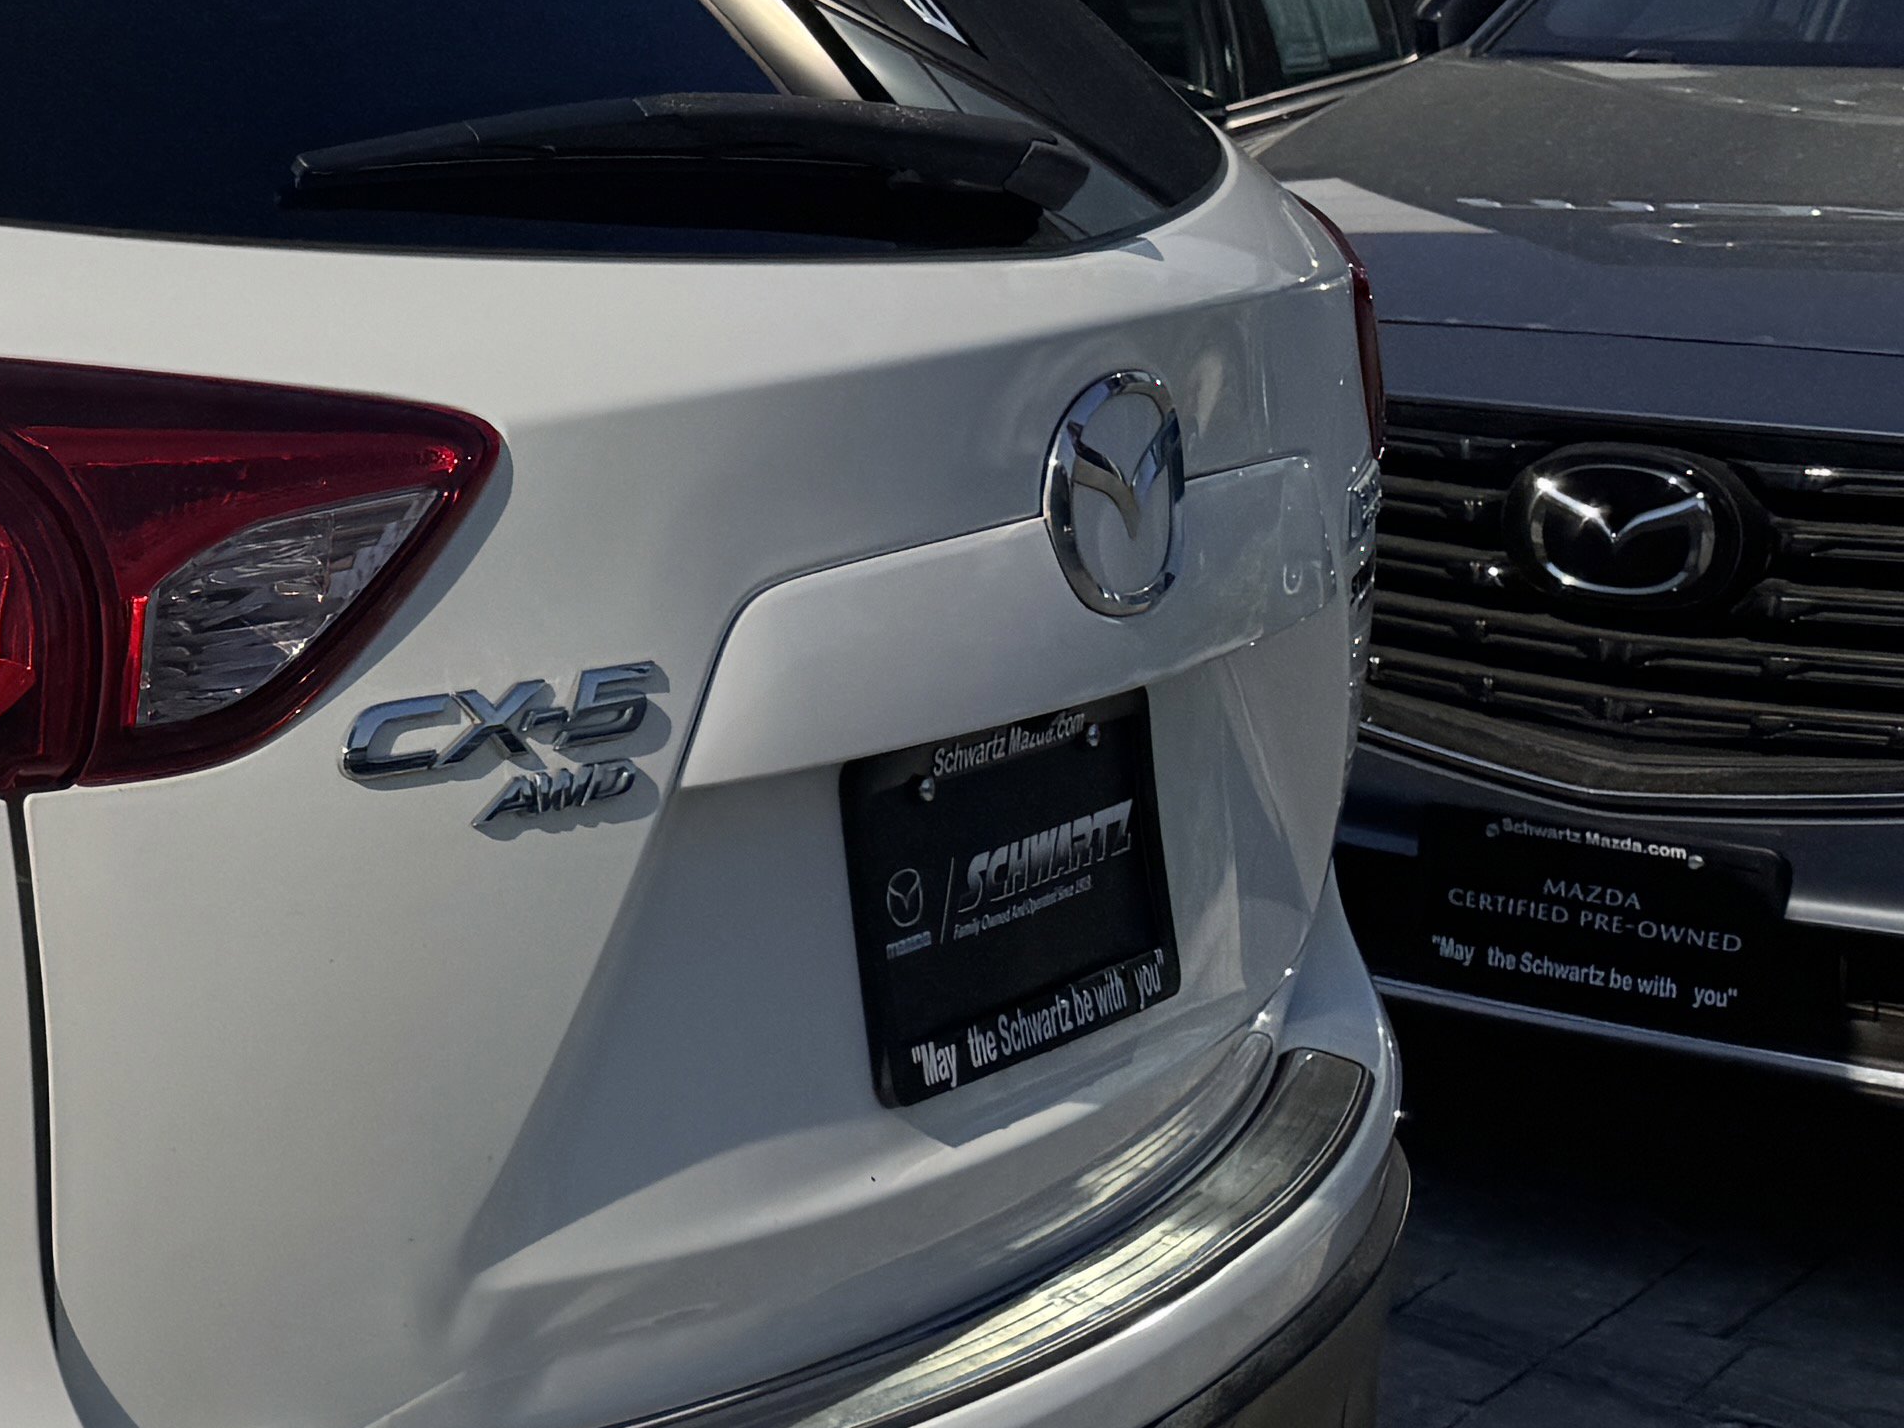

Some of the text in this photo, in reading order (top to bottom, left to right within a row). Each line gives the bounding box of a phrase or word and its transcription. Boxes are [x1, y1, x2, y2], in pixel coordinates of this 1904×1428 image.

[339, 660, 656, 780] CX-5
[933, 733, 1007, 777] Schwartz
[471, 758, 636, 827] AWD
[957, 799, 1133, 913] SCHWARTZ
[1502, 816, 1688, 860] Schwartz Mazda.com
[1447, 886, 1743, 953] CERTIFIED PRE-OWNED
[1543, 877, 1642, 911] MAZDA
[1431, 933, 1739, 1009] "May the Schwartz be with you"
[911, 947, 1165, 1089] "May the Schwartz be with you"
